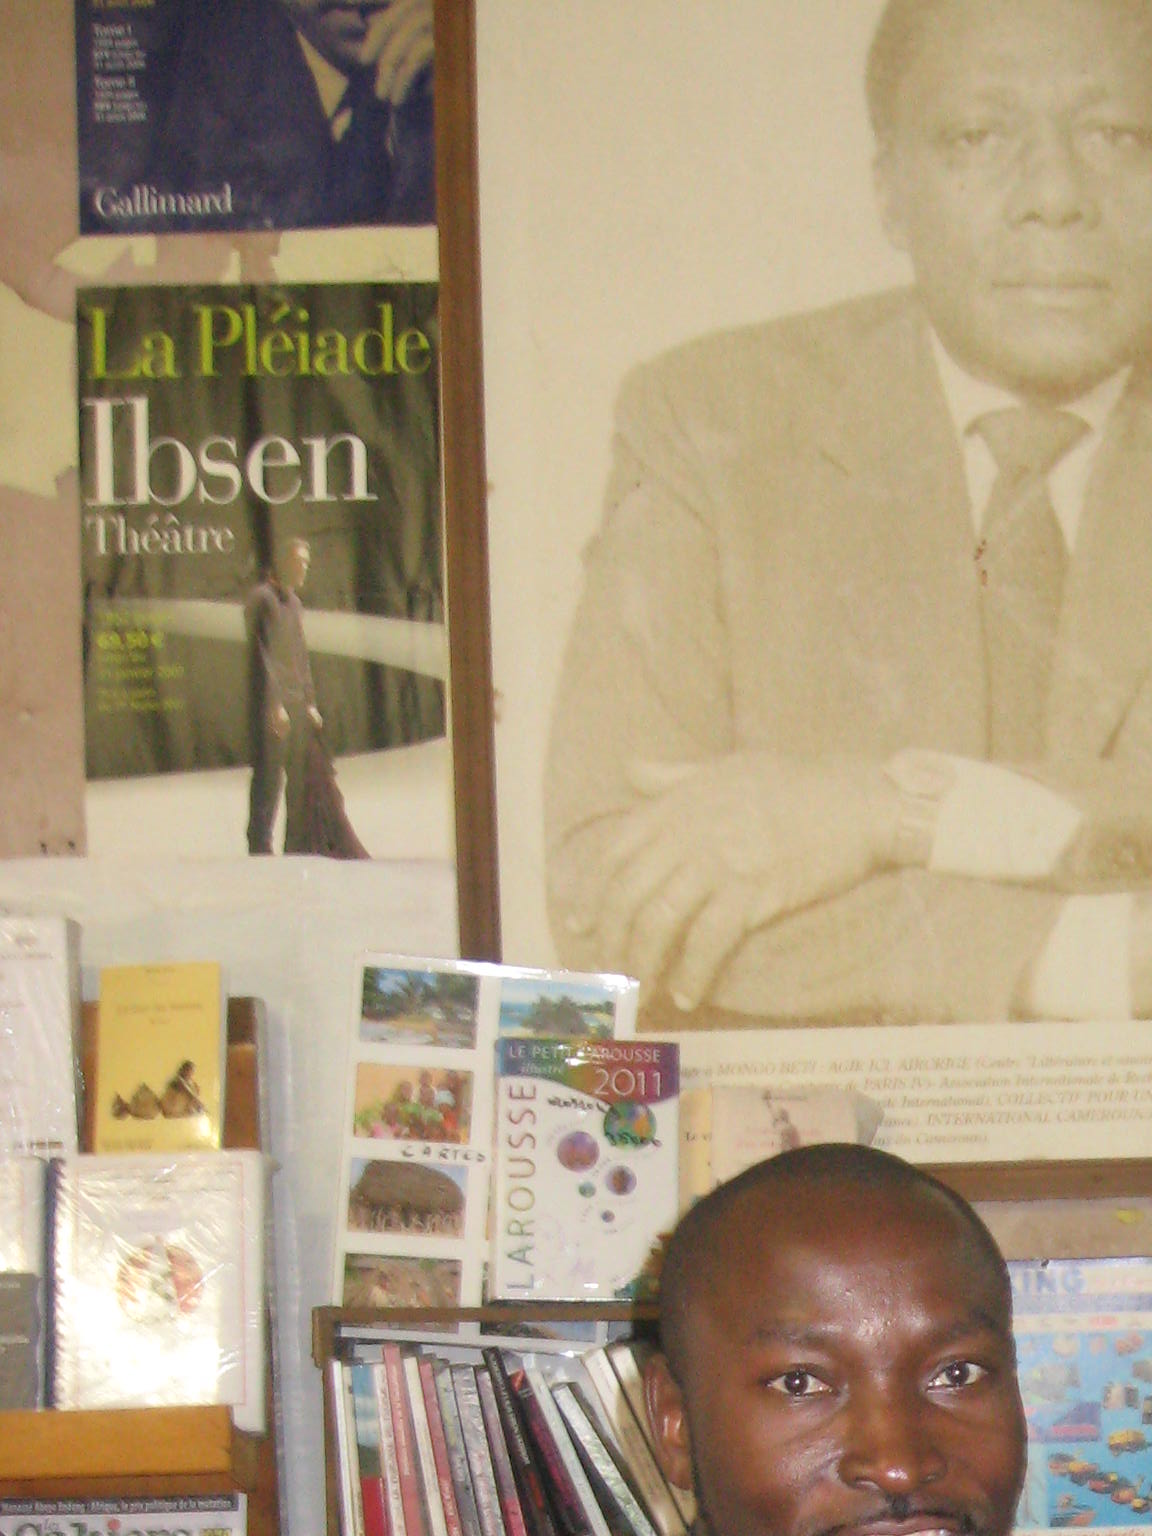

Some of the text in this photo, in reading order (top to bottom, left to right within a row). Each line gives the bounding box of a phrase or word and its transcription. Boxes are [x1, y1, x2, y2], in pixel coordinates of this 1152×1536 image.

[95, 182, 233, 219] Gallimard
[86, 294, 432, 380] La Pléiade
[80, 396, 379, 507] Ibsen
[84, 512, 236, 557] Théâtre
[508, 1044, 528, 1059] LE
[578, 1046, 662, 1063] AROUSSE
[592, 1068, 662, 1098] 2011
[506, 1083, 538, 1292] LAROUSSE
